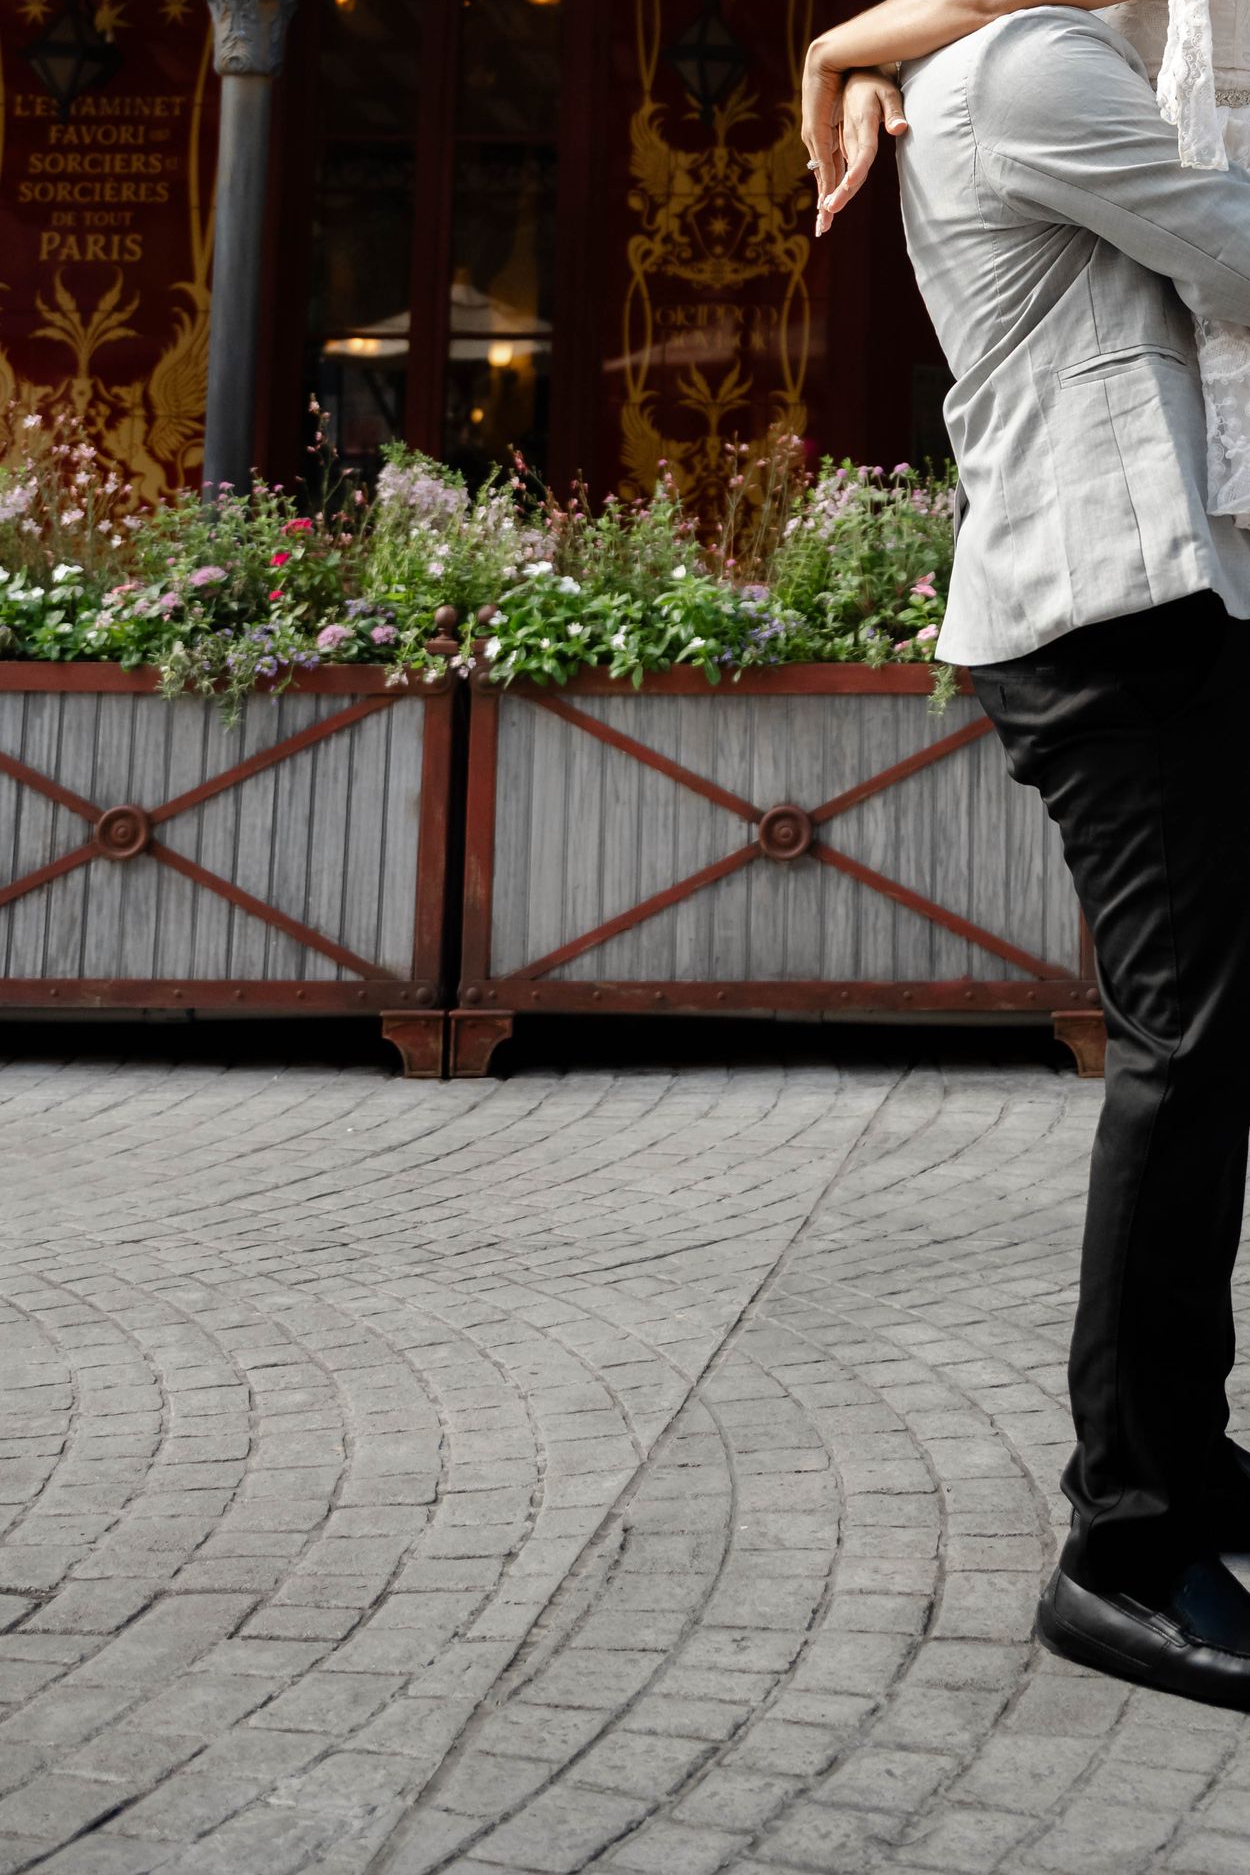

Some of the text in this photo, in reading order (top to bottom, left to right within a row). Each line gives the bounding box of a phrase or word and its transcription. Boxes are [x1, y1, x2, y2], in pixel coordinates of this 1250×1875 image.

[50, 124, 145, 145] FAVORI
[28, 152, 163, 174] SORCIERS
[17, 176, 170, 204] SORCIÈRES
[83, 210, 134, 226] TOUT
[39, 231, 144, 262] PARIS
